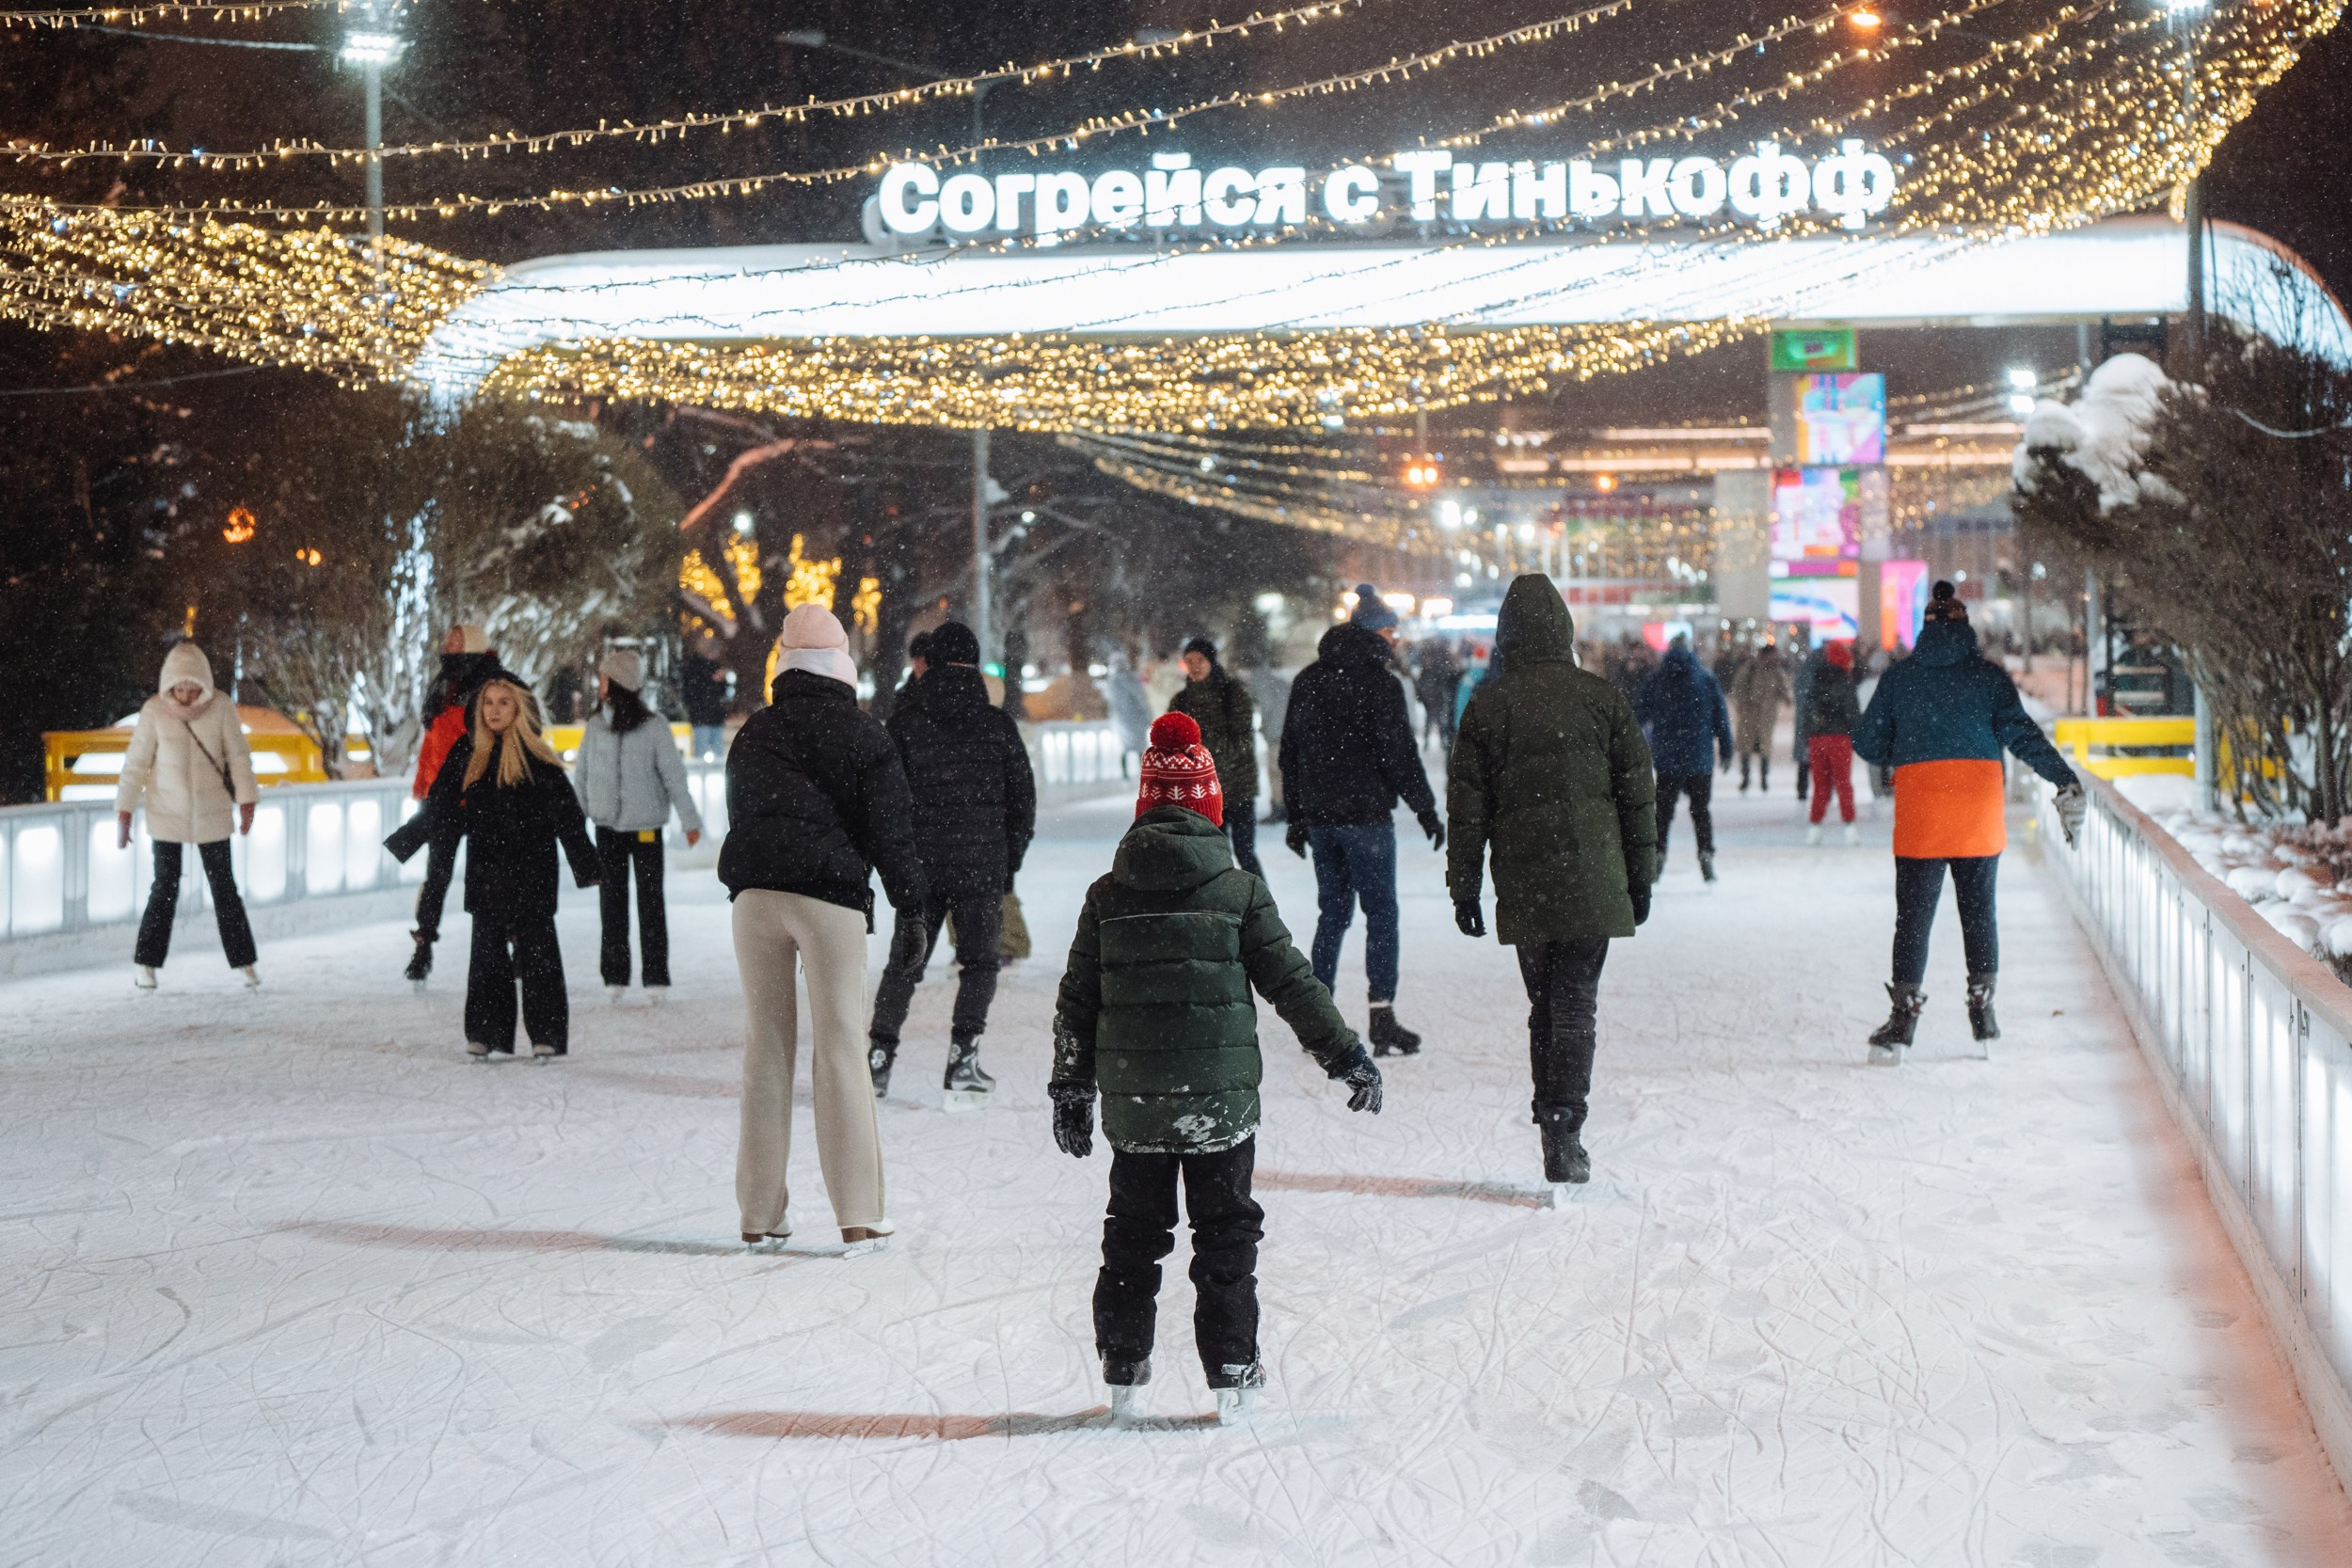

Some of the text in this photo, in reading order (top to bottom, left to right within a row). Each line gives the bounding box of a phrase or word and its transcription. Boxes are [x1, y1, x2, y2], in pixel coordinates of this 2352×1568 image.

[878, 138, 1897, 247] Согрейся с Тинькофф
